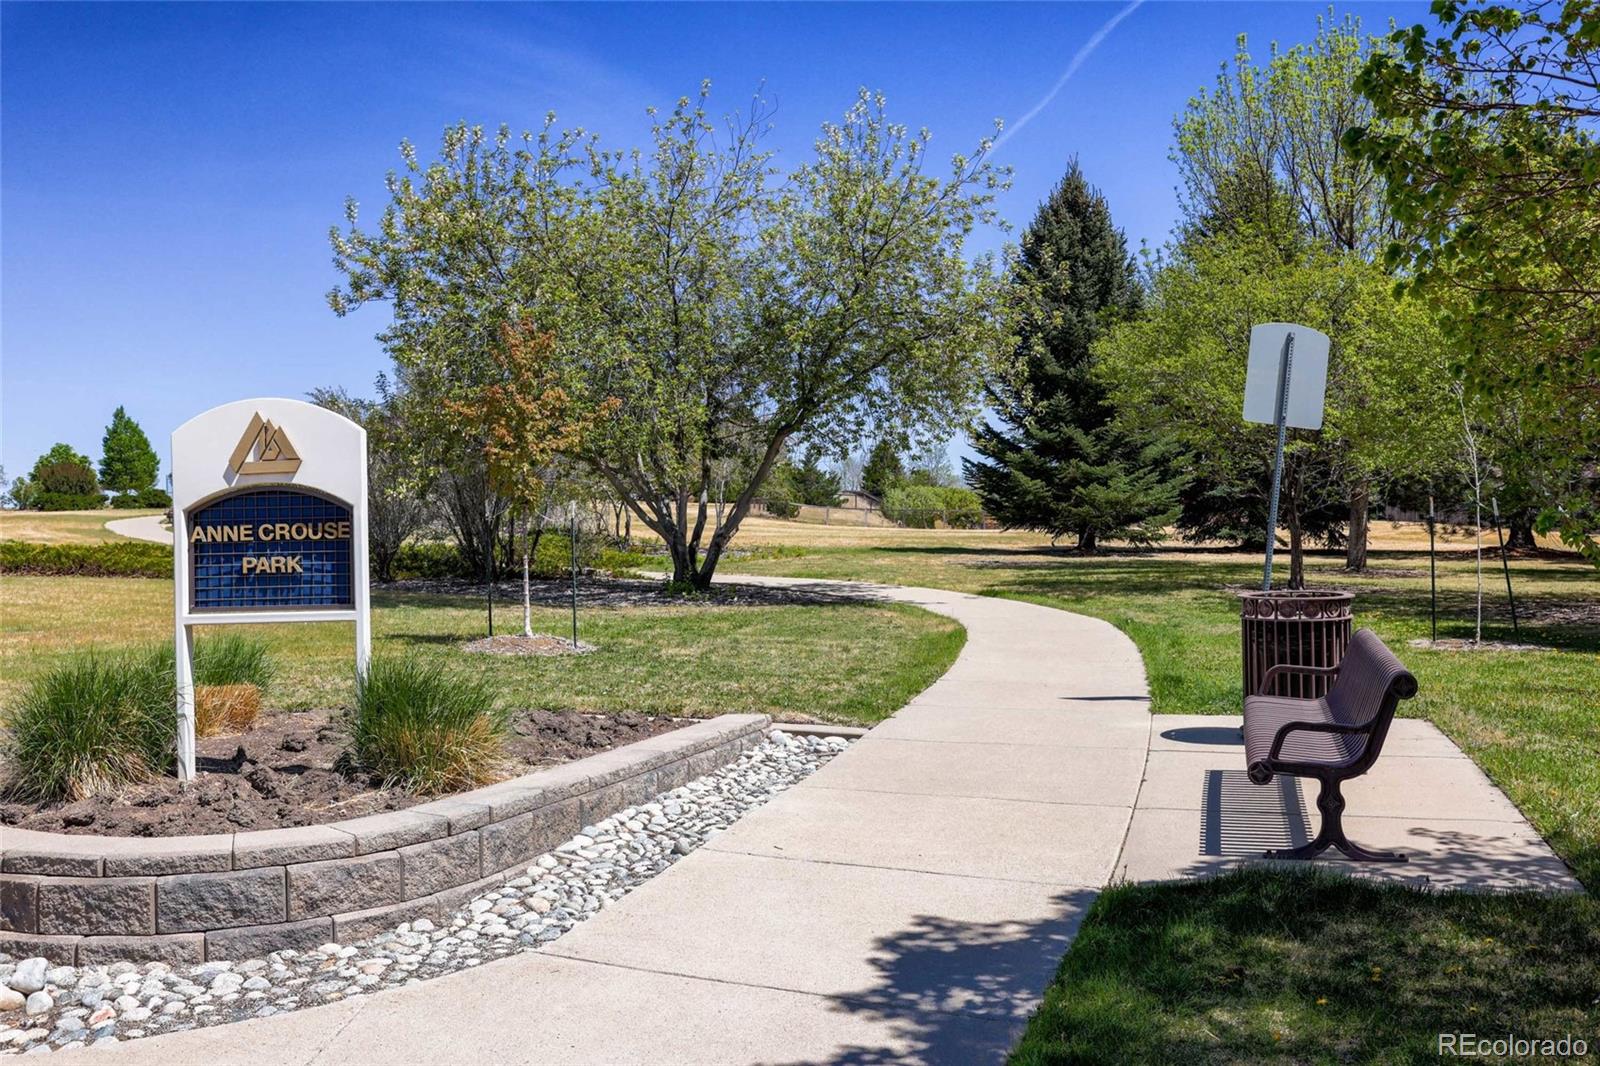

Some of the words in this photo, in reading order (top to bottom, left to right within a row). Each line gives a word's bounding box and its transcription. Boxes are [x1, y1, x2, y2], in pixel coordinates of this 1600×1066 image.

[190, 524, 254, 543] ANNE
[258, 522, 351, 541] CROUSE
[242, 555, 304, 574] PARK
